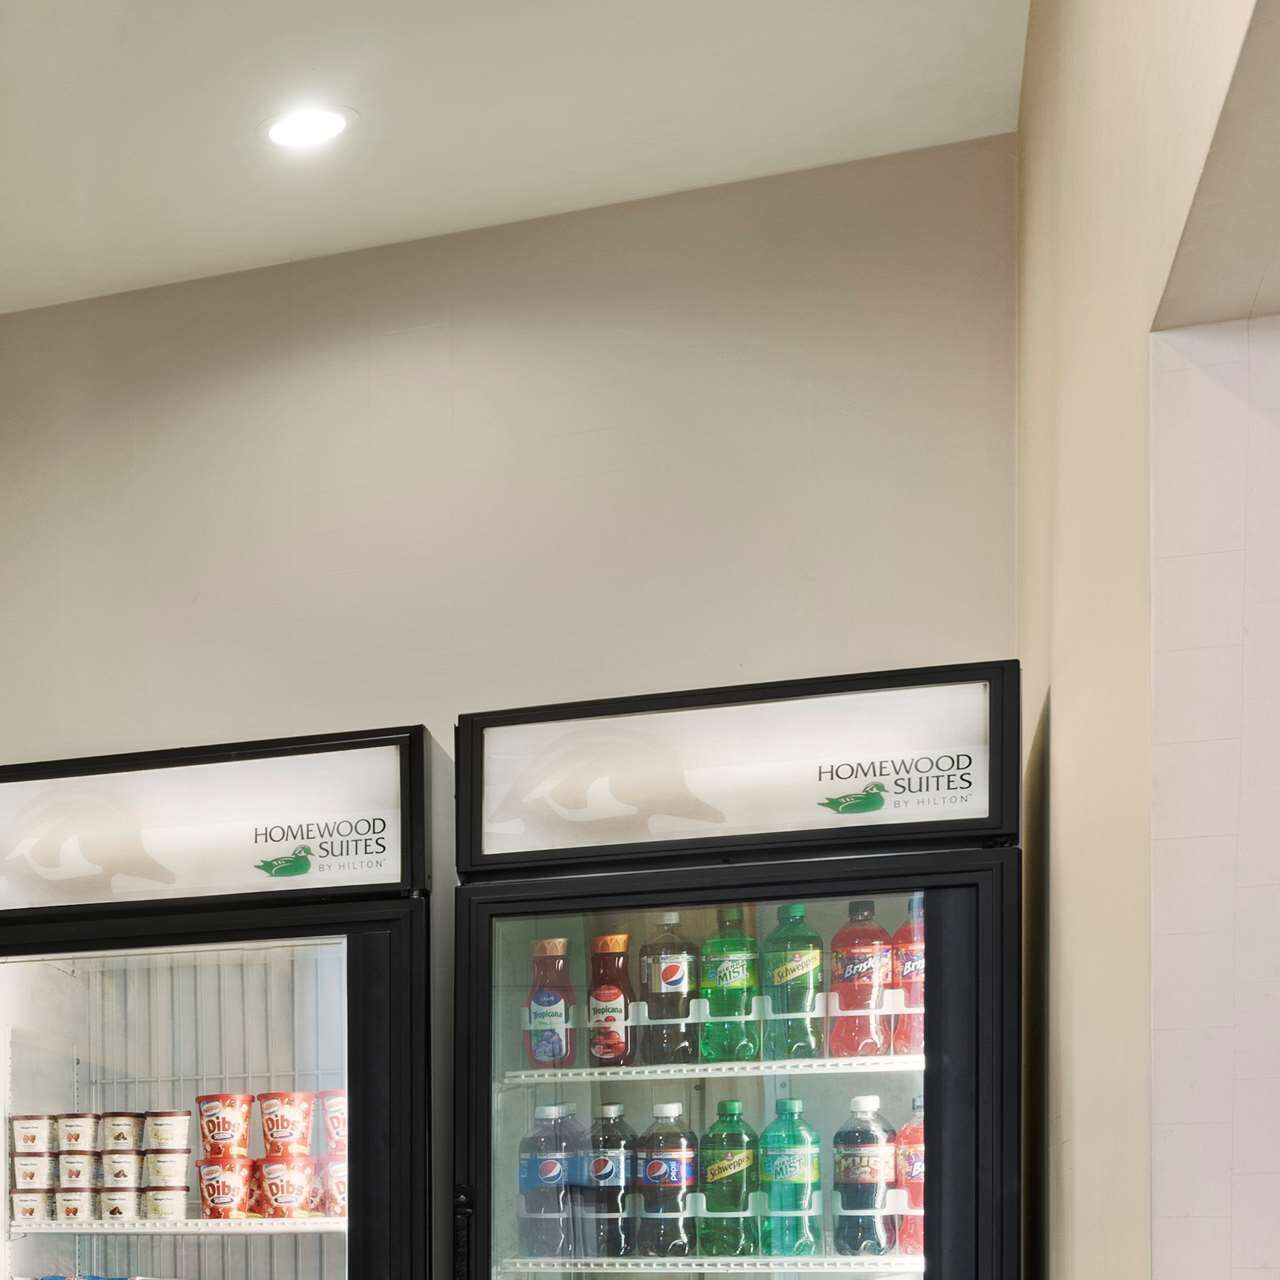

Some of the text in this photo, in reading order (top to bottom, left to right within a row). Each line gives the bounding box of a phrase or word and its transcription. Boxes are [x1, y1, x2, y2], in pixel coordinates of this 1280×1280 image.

[817, 754, 972, 782] HOMEWOOD
[893, 772, 973, 795] SUITES
[893, 794, 969, 809] BY HILTON
[254, 817, 387, 844] HOMEWOOD
[318, 837, 386, 858] SUITES
[318, 859, 383, 872] BY HILTON
[717, 965, 748, 985] MIST
[531, 1008, 563, 1020] Tropicana
[591, 1004, 624, 1016] Tropicana
[205, 1115, 237, 1133] Dibs
[775, 1158, 804, 1178] MIST
